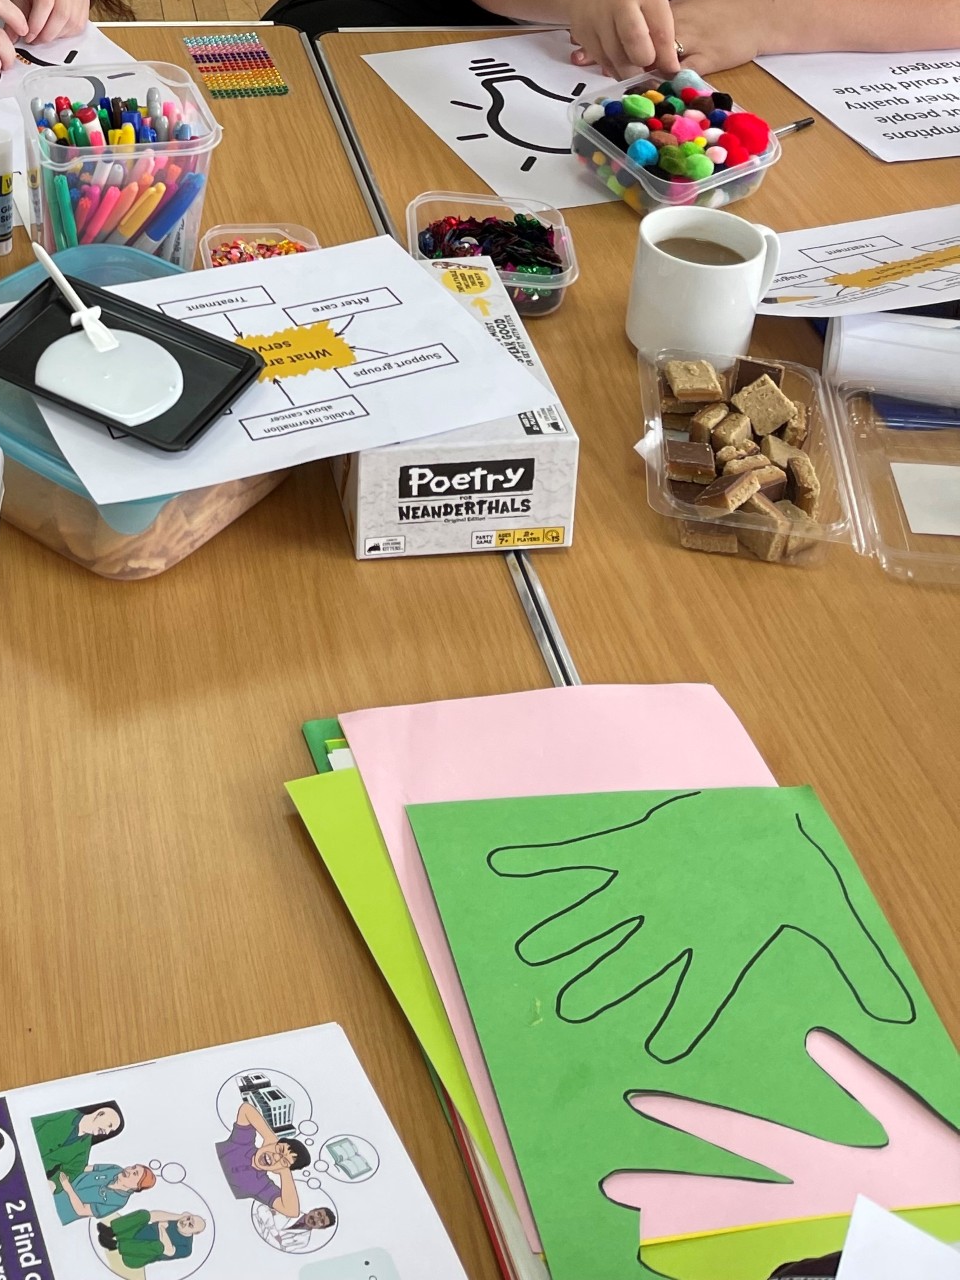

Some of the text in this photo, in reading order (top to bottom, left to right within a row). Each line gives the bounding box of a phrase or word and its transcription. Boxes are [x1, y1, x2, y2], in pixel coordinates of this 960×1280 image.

[860, 84, 897, 92] this
[898, 78, 948, 89] could
[845, 93, 960, 111] their quality
[874, 109, 942, 125] people
[825, 244, 876, 255] Treatment
[186, 296, 248, 312] Treatment
[312, 296, 370, 314] After care
[494, 320, 512, 338] GOOD
[293, 348, 332, 366] What
[354, 352, 442, 378] Support groups
[263, 410, 356, 434] Public information
[270, 405, 333, 422] about cancer
[408, 466, 525, 496] Poetry
[398, 498, 531, 521] NEANDERTHALS
[5, 1200, 26, 1220] 2.
[12, 1222, 42, 1268] Find
